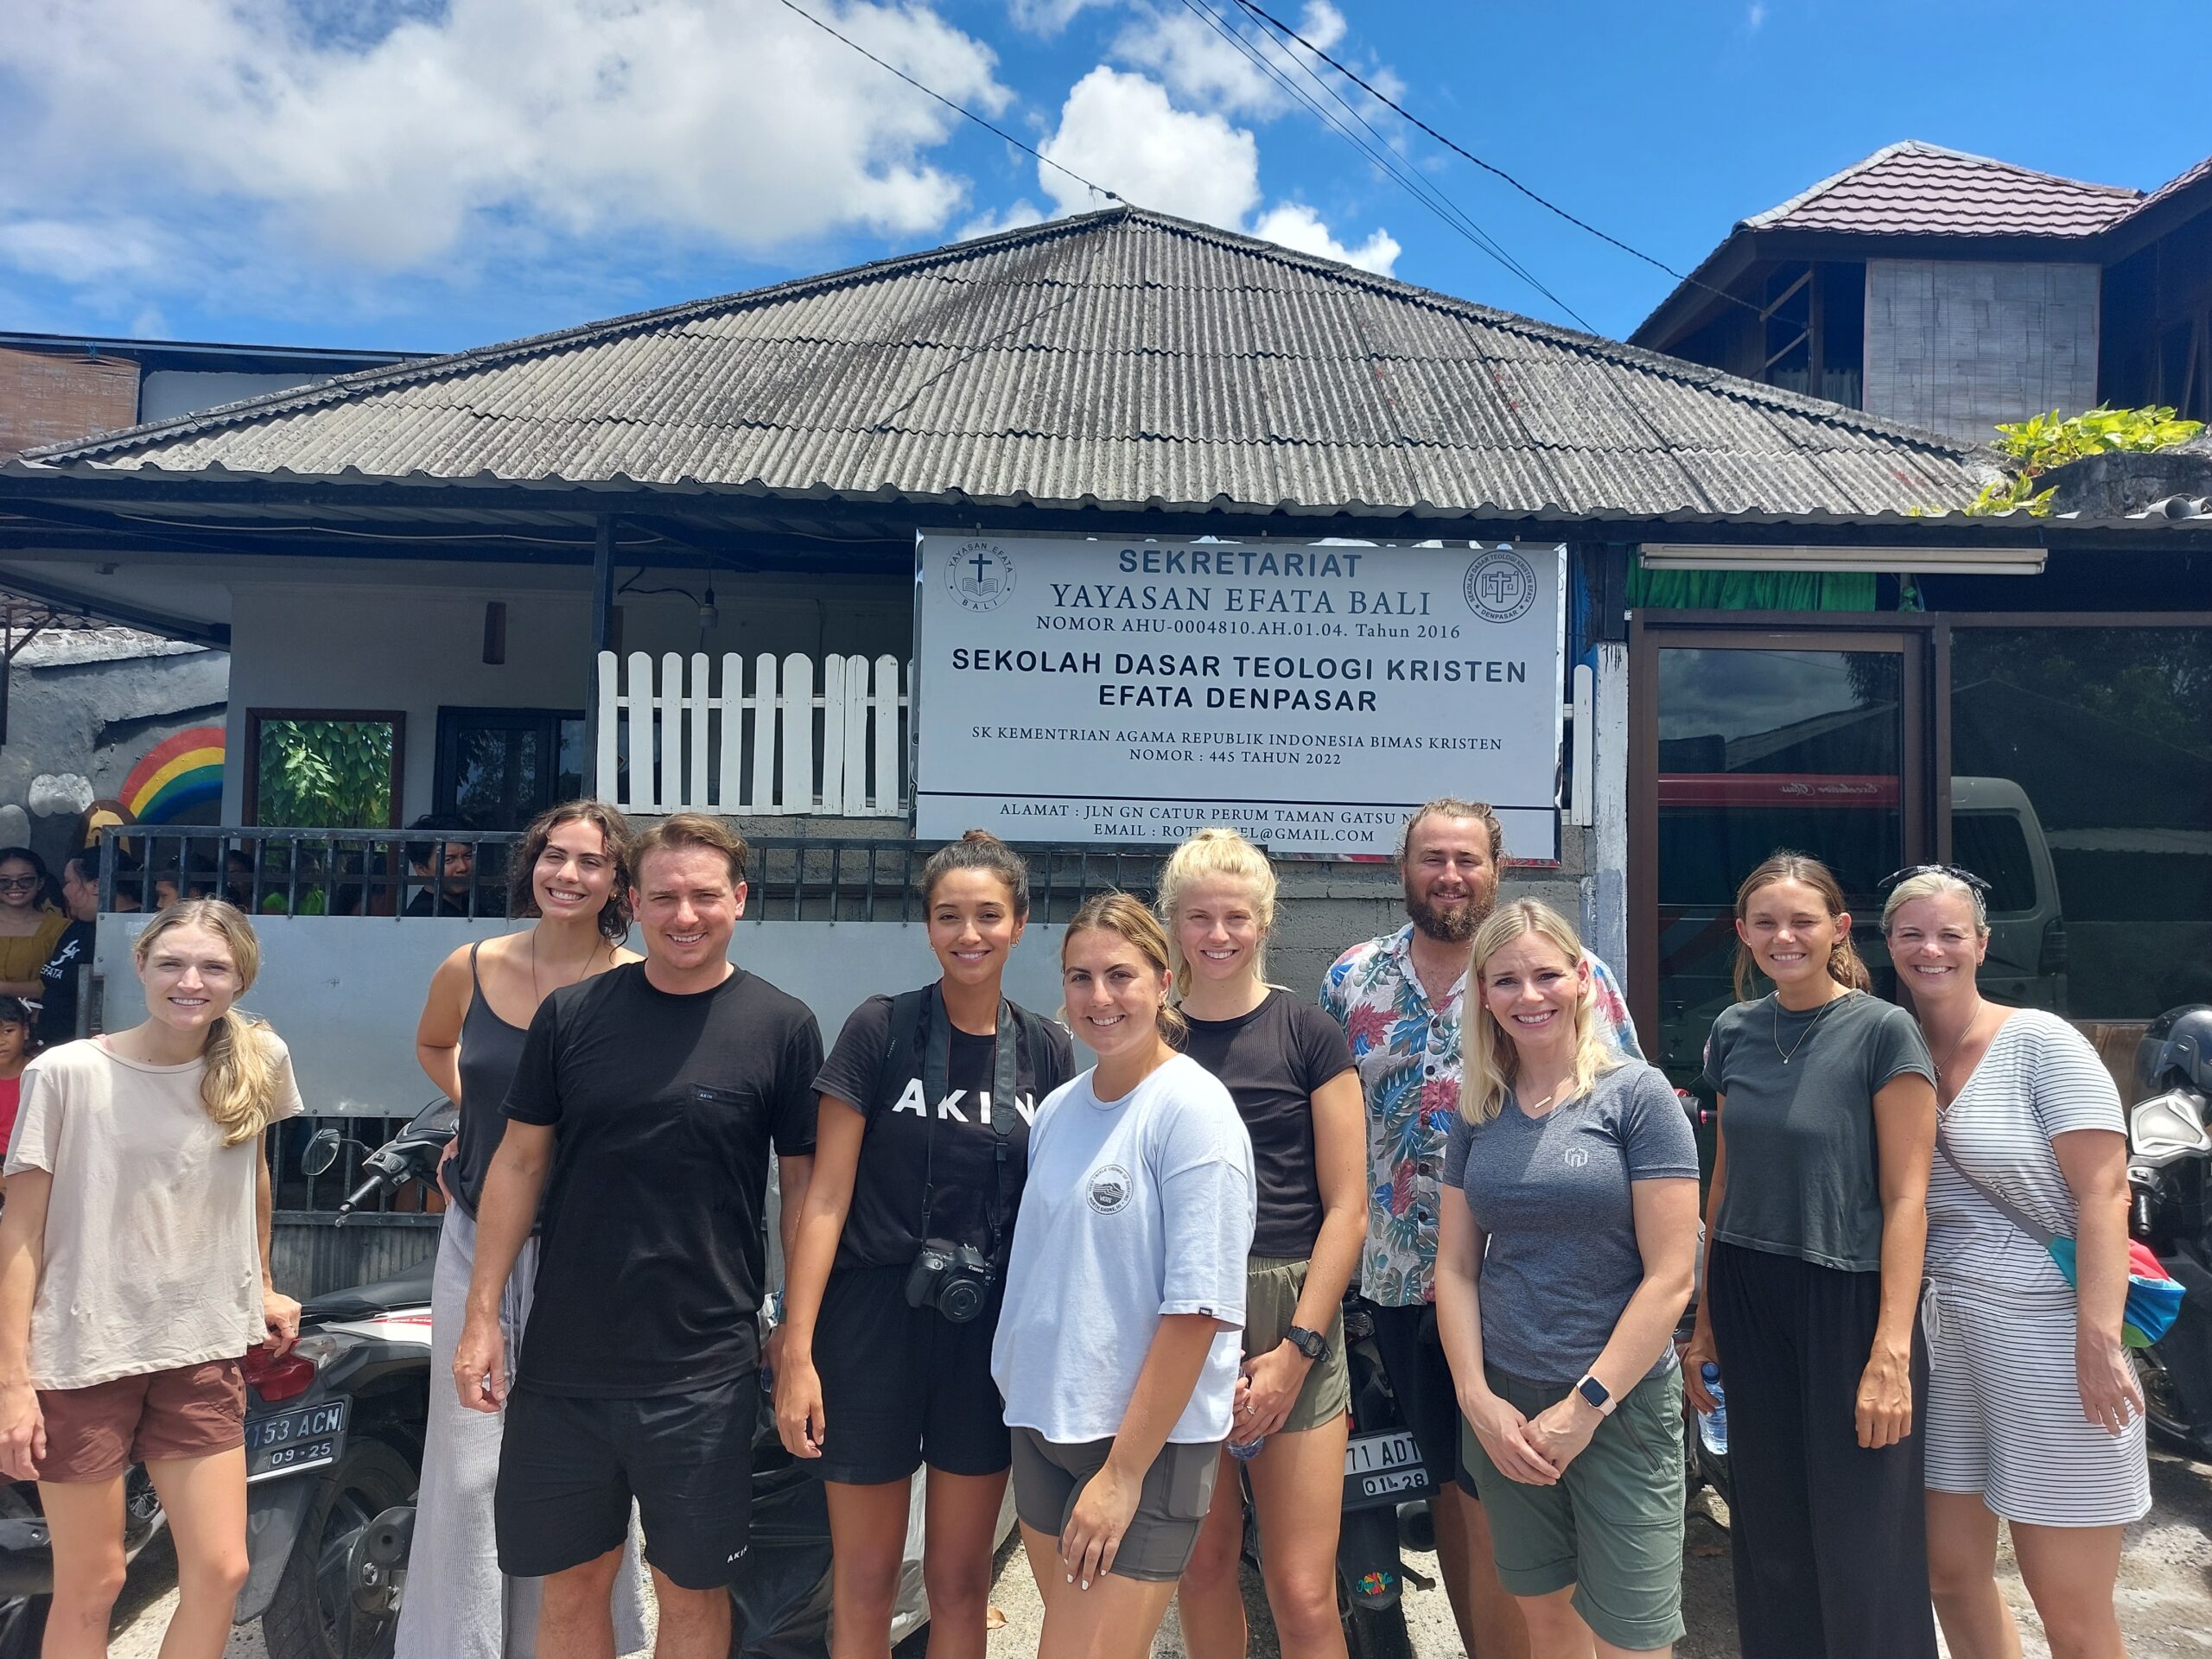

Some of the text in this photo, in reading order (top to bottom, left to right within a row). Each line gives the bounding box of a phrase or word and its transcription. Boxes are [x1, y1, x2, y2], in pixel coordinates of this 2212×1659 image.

[948, 542, 1014, 573] YAYASAN EFATA
[1119, 549, 1363, 577] SEKRETARIAT
[1471, 556, 1489, 574] DASAR
[1491, 553, 1516, 563] TEOLOGI
[1516, 560, 1533, 583] KRISTEN
[962, 599, 998, 610] BALI
[1050, 583, 1431, 615] YAYASAN EFATA BALI
[1523, 584, 1533, 603] EFATA
[1480, 609, 1518, 620] DENPASAR
[1037, 615, 1116, 632] NOMOR
[1356, 623, 1410, 638] Tahun
[1417, 625, 1460, 639] 2016
[952, 649, 1526, 683] SEKOLAH DASAR TEOLOGI KRISTEN
[1099, 685, 1376, 712] EFATA DENPASAR
[972, 726, 1502, 750] SK KEMENTRIAN AGAMA REPUBLIK INDONESIA BIMAS KRISTEN
[1129, 748, 1194, 762] NOMOR
[1210, 751, 1235, 763] 445
[1242, 751, 1300, 764] TAHUN
[1306, 753, 1341, 765] 2022
[999, 804, 1070, 817] ALAMAT
[1084, 805, 1114, 820] JLN
[1120, 807, 1144, 819] GN
[1150, 808, 1205, 821] CATUR
[1211, 809, 1269, 822] PERUM
[1274, 810, 1335, 823] TAMAN
[1341, 811, 1395, 825] GATSU
[1093, 823, 1147, 837] EMAIL
[968, 1264, 985, 1274] Canon
[1382, 1437, 1419, 1466] ADT
